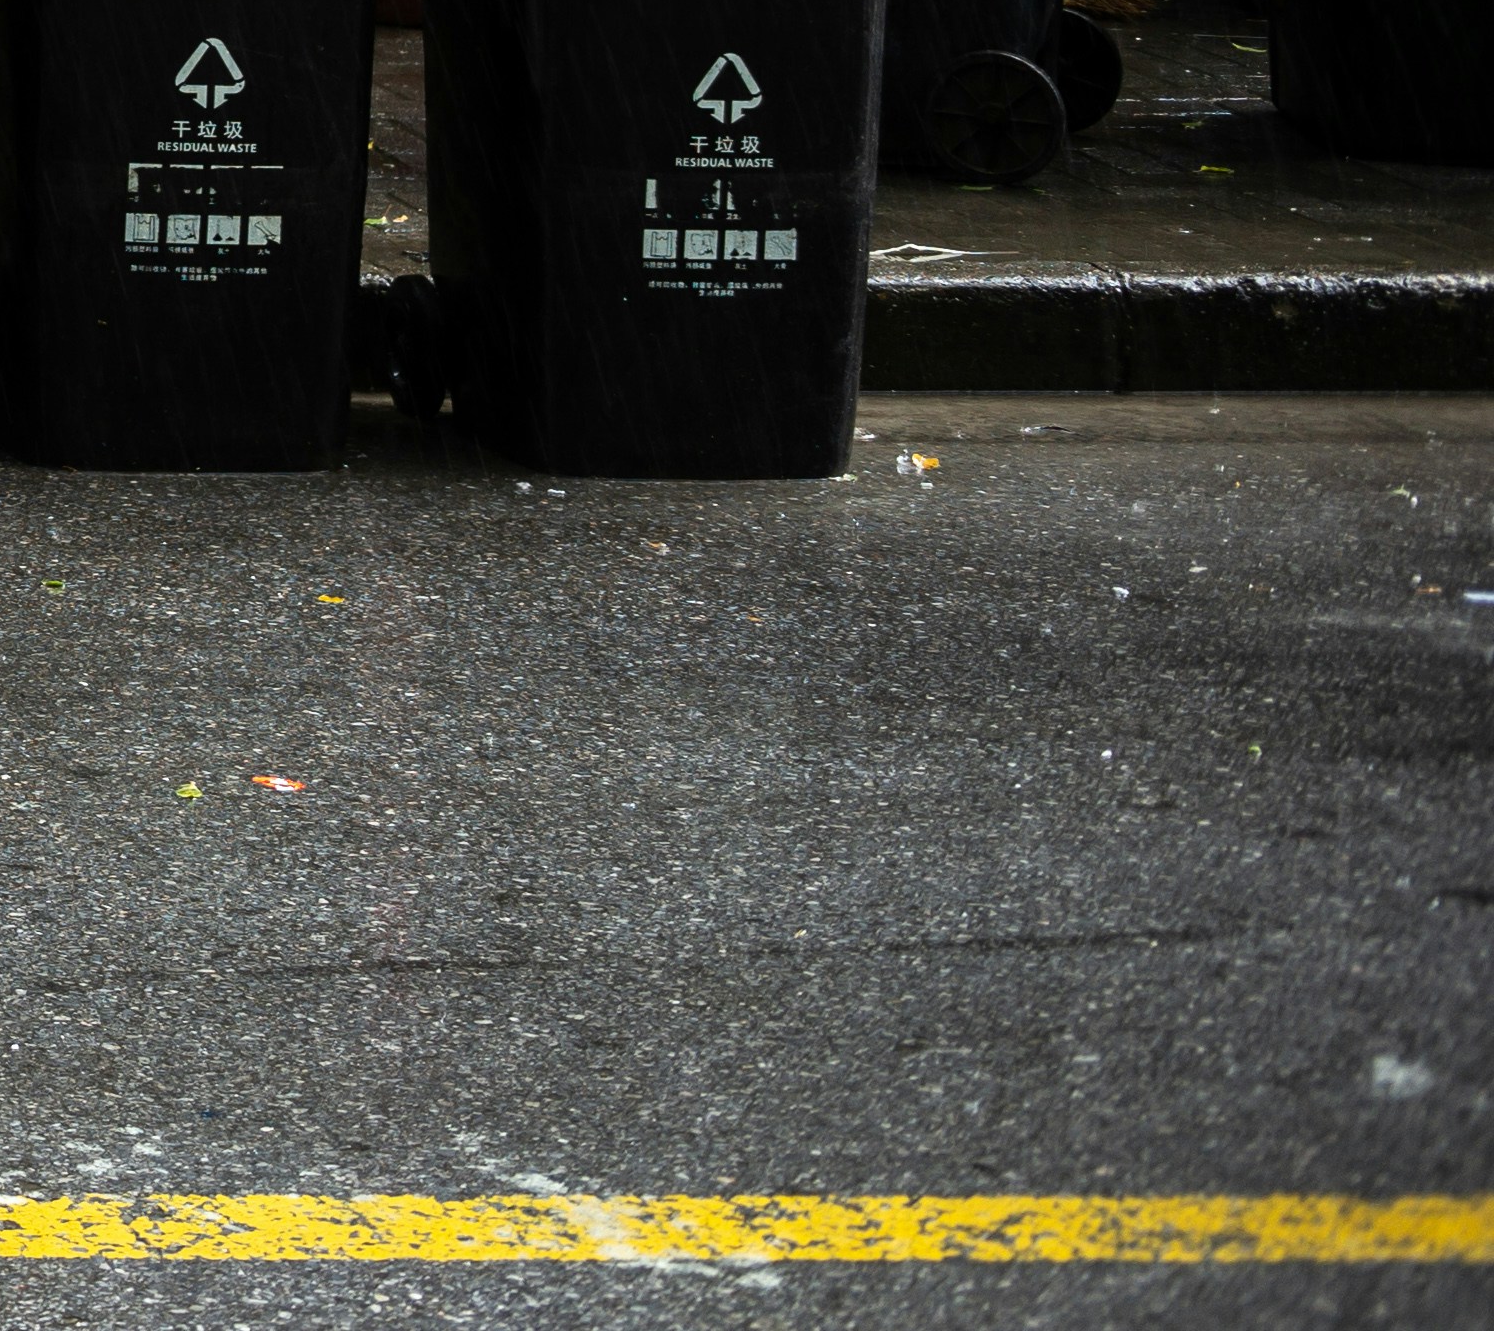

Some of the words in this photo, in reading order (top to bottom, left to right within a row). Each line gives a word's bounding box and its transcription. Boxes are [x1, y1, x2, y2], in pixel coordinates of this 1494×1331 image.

[171, 120, 244, 140] 干垃圾
[157, 141, 215, 153] RESIDUAL
[217, 142, 258, 154] WASTE
[689, 135, 761, 155] 干垃圾
[675, 157, 732, 169] RESIDUAL
[734, 157, 775, 169] WASTE
